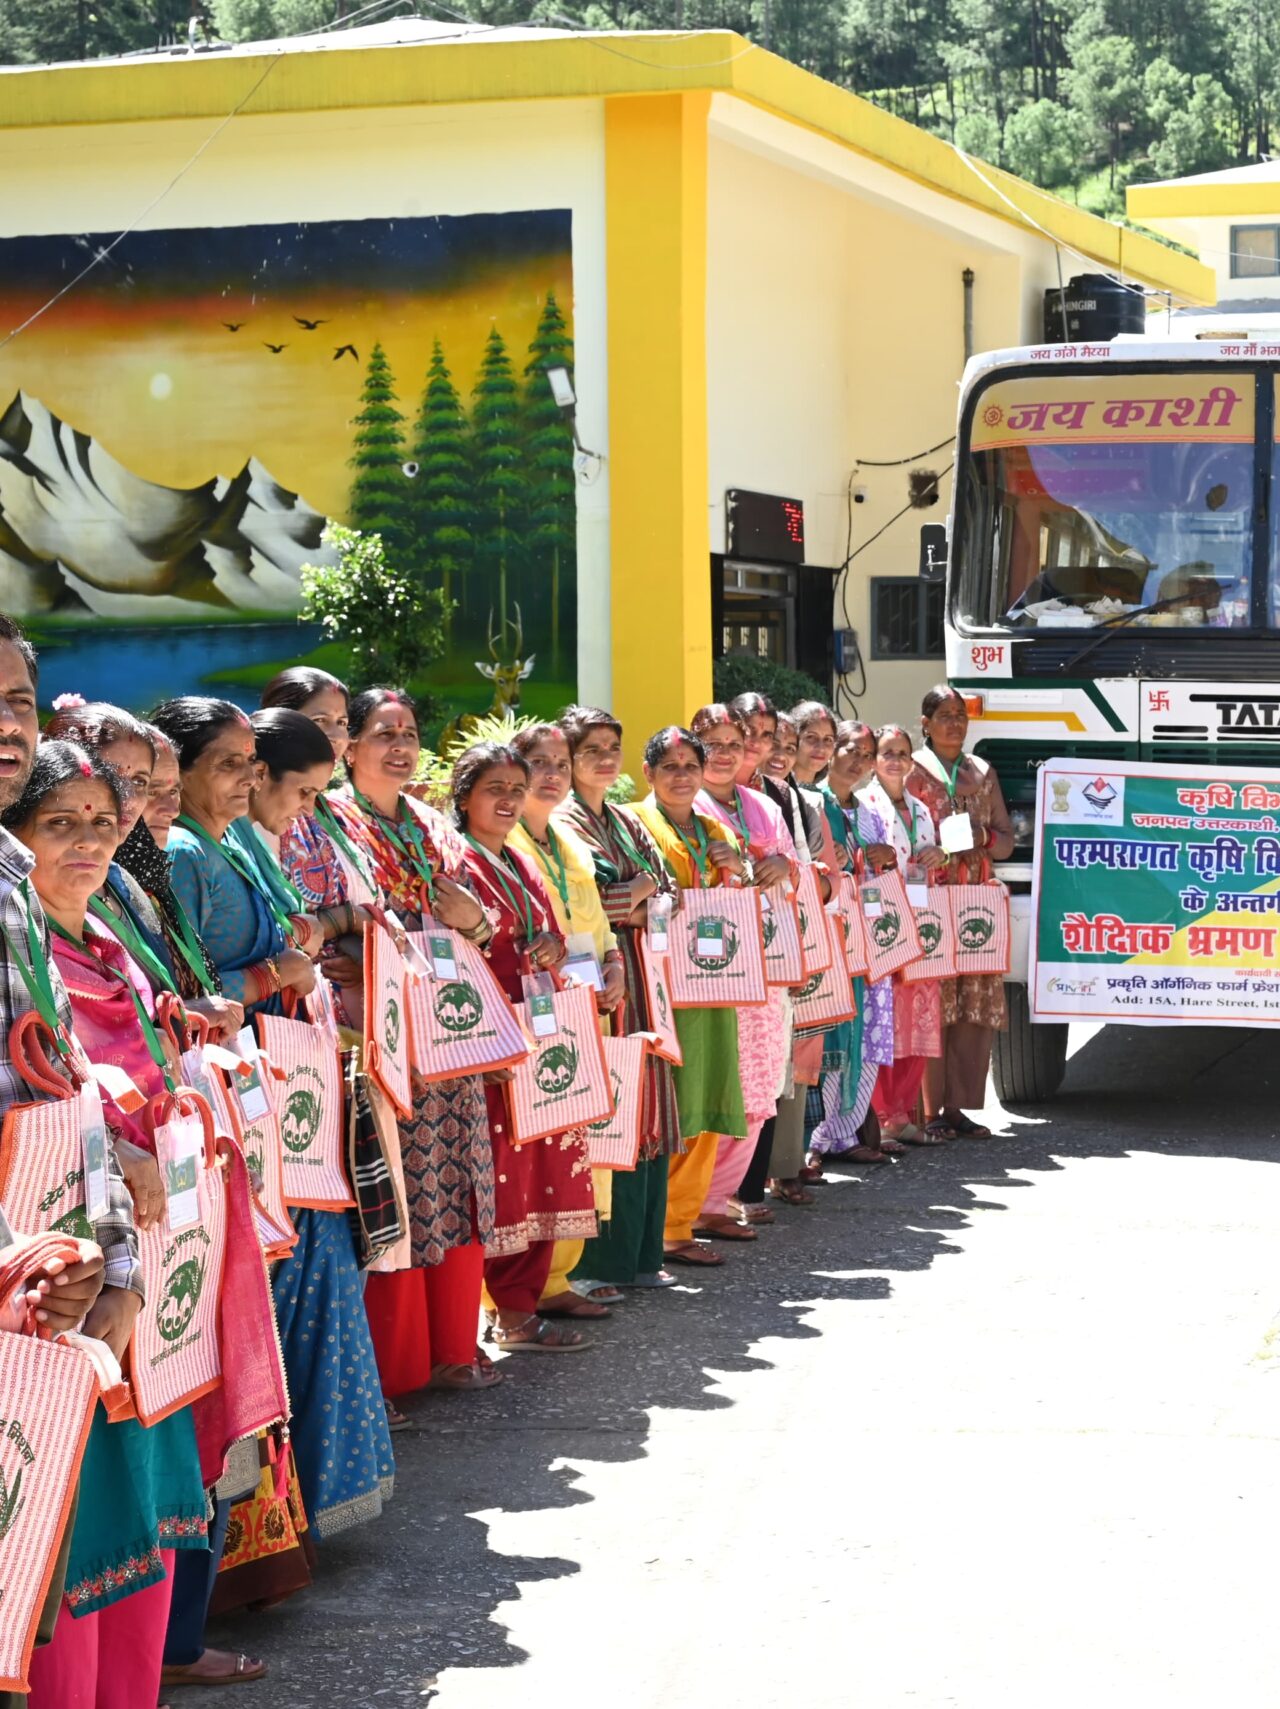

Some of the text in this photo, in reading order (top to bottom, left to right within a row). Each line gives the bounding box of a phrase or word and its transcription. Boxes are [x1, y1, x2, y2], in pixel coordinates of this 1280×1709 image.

[1030, 349, 1051, 359] जय
[1054, 345, 1077, 358] गंगे
[1220, 345, 1240, 356] जय
[1007, 401, 1095, 431] जय
[1102, 387, 1242, 428] काशी
[971, 645, 1004, 671] शुभ
[1178, 783, 1235, 813] कृषि
[1131, 813, 1190, 829] जनपद
[1054, 838, 1181, 869] परम्परागत
[1187, 836, 1247, 882] कृषि
[1180, 886, 1208, 914] के
[1061, 912, 1175, 954] शैक्षिक
[1188, 925, 1277, 957] भ्रमण
[1107, 976, 1147, 992] प्रकृति
[1217, 978, 1249, 992] फार्म
[1252, 980, 1279, 994] फ्रेश
[1111, 995, 1144, 1005] Add:
[1149, 996, 1176, 1008] 15A,
[1180, 997, 1213, 1007] Hare
